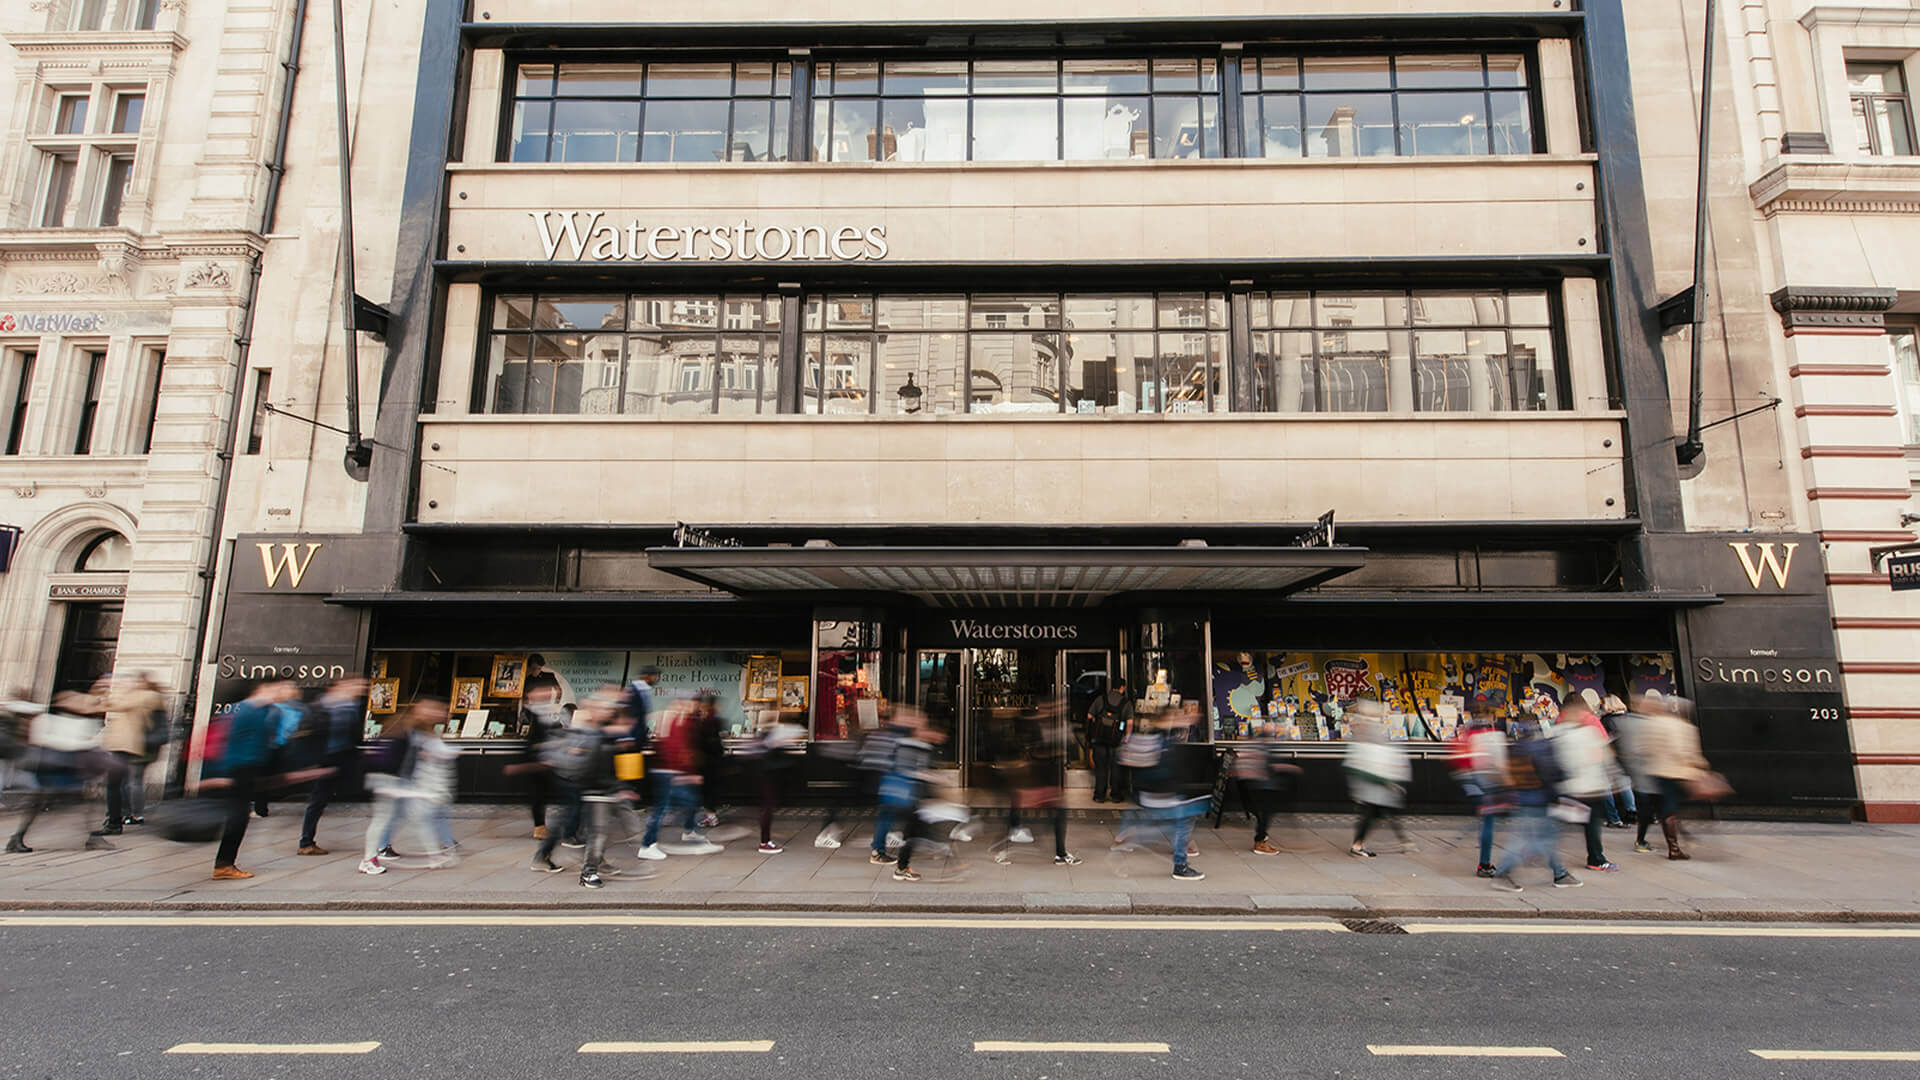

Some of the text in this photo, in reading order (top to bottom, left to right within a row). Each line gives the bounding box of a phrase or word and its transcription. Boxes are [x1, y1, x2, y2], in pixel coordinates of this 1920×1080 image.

[528, 210, 889, 261] Waterstones
[20, 314, 101, 331] NatWest
[255, 542, 322, 588] W
[1728, 542, 1800, 589] W
[57, 586, 121, 594] BANK CHAMBERS
[950, 619, 1078, 639] Waterstones
[273, 646, 300, 654] formerly
[1750, 649, 1778, 657] formerly
[656, 655, 717, 667] Elizabeth
[656, 670, 742, 682] Jane Howard
[1325, 670, 1370, 688] BOOK
[1810, 708, 1839, 720] 203
